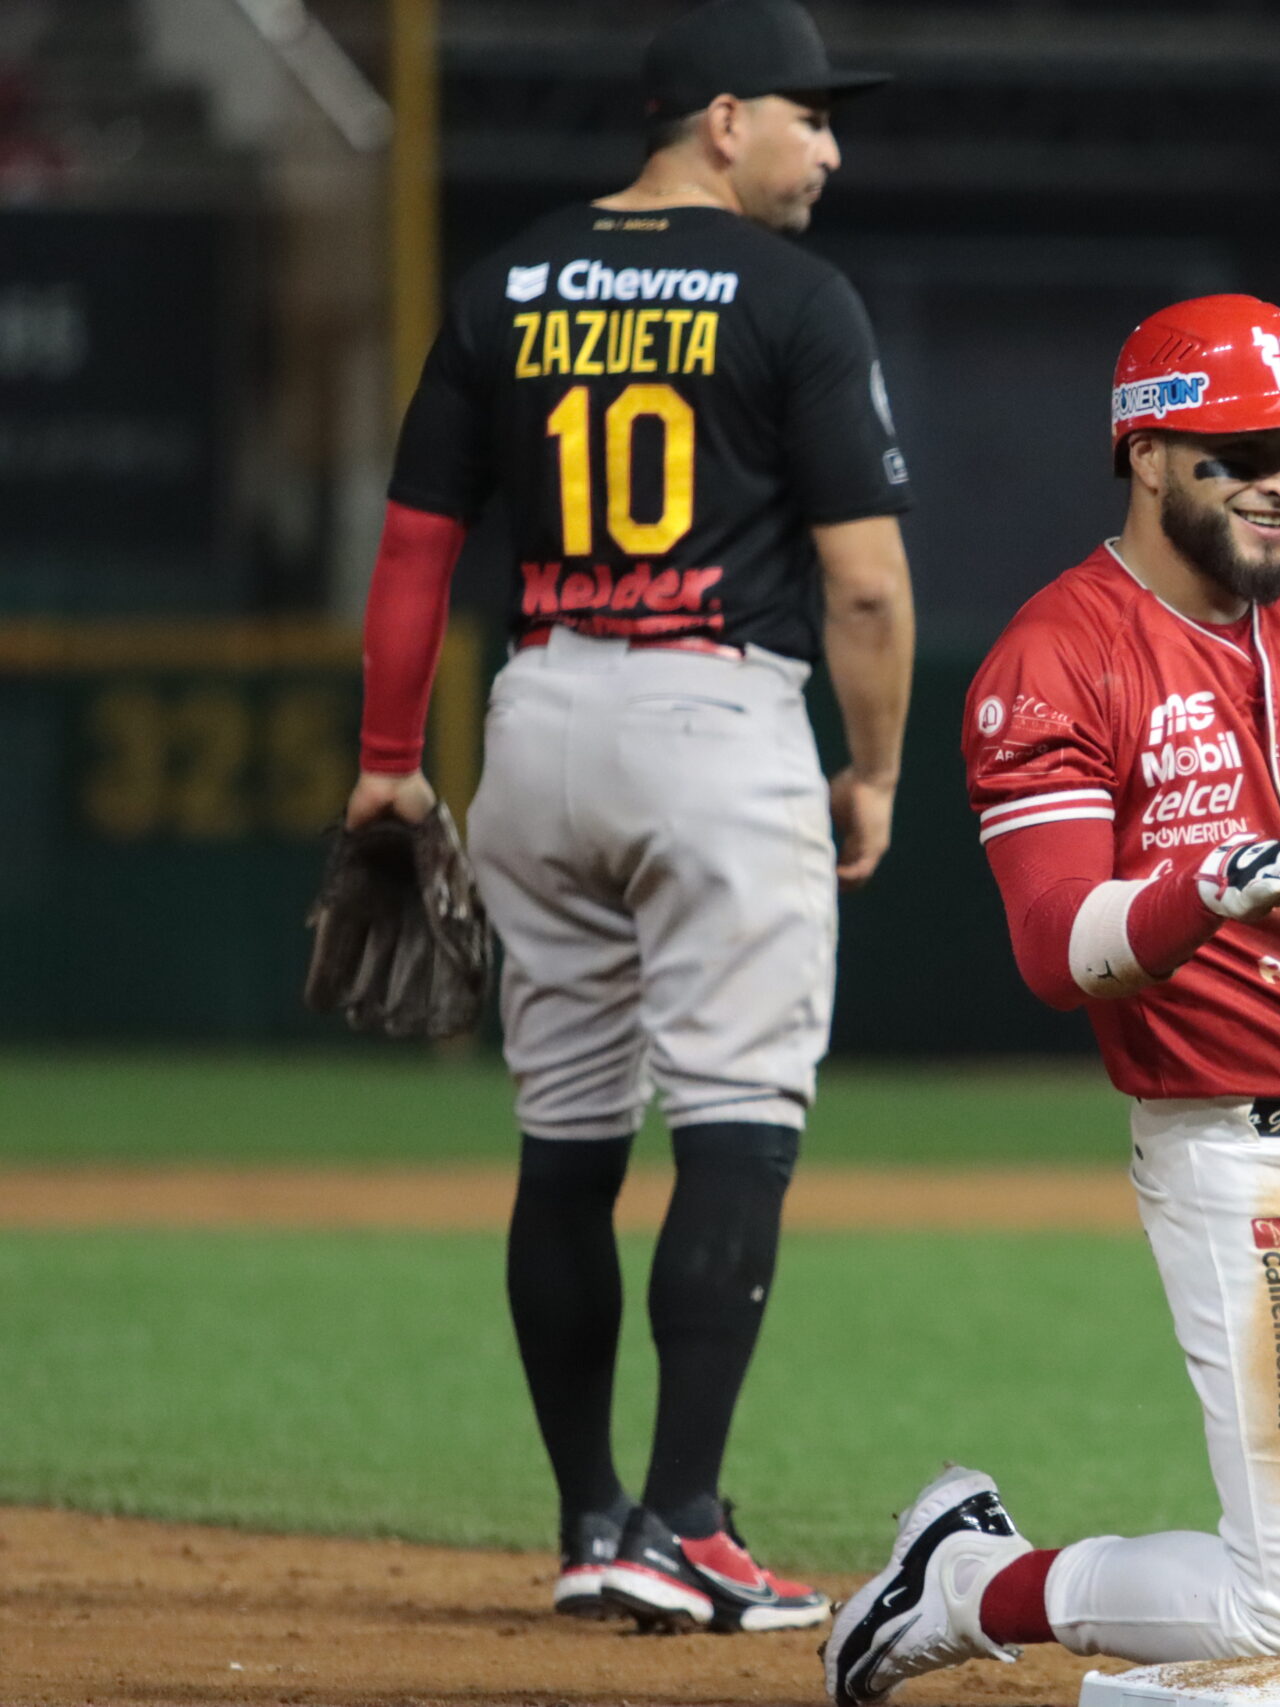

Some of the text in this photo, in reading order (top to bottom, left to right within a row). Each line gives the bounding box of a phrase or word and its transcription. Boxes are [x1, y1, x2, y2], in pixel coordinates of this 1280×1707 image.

[558, 258, 738, 304] Chevron
[513, 309, 719, 379] ZAZUETA
[547, 383, 694, 556] 10
[1141, 731, 1243, 788] Mobil
[1142, 773, 1244, 825] telcel
